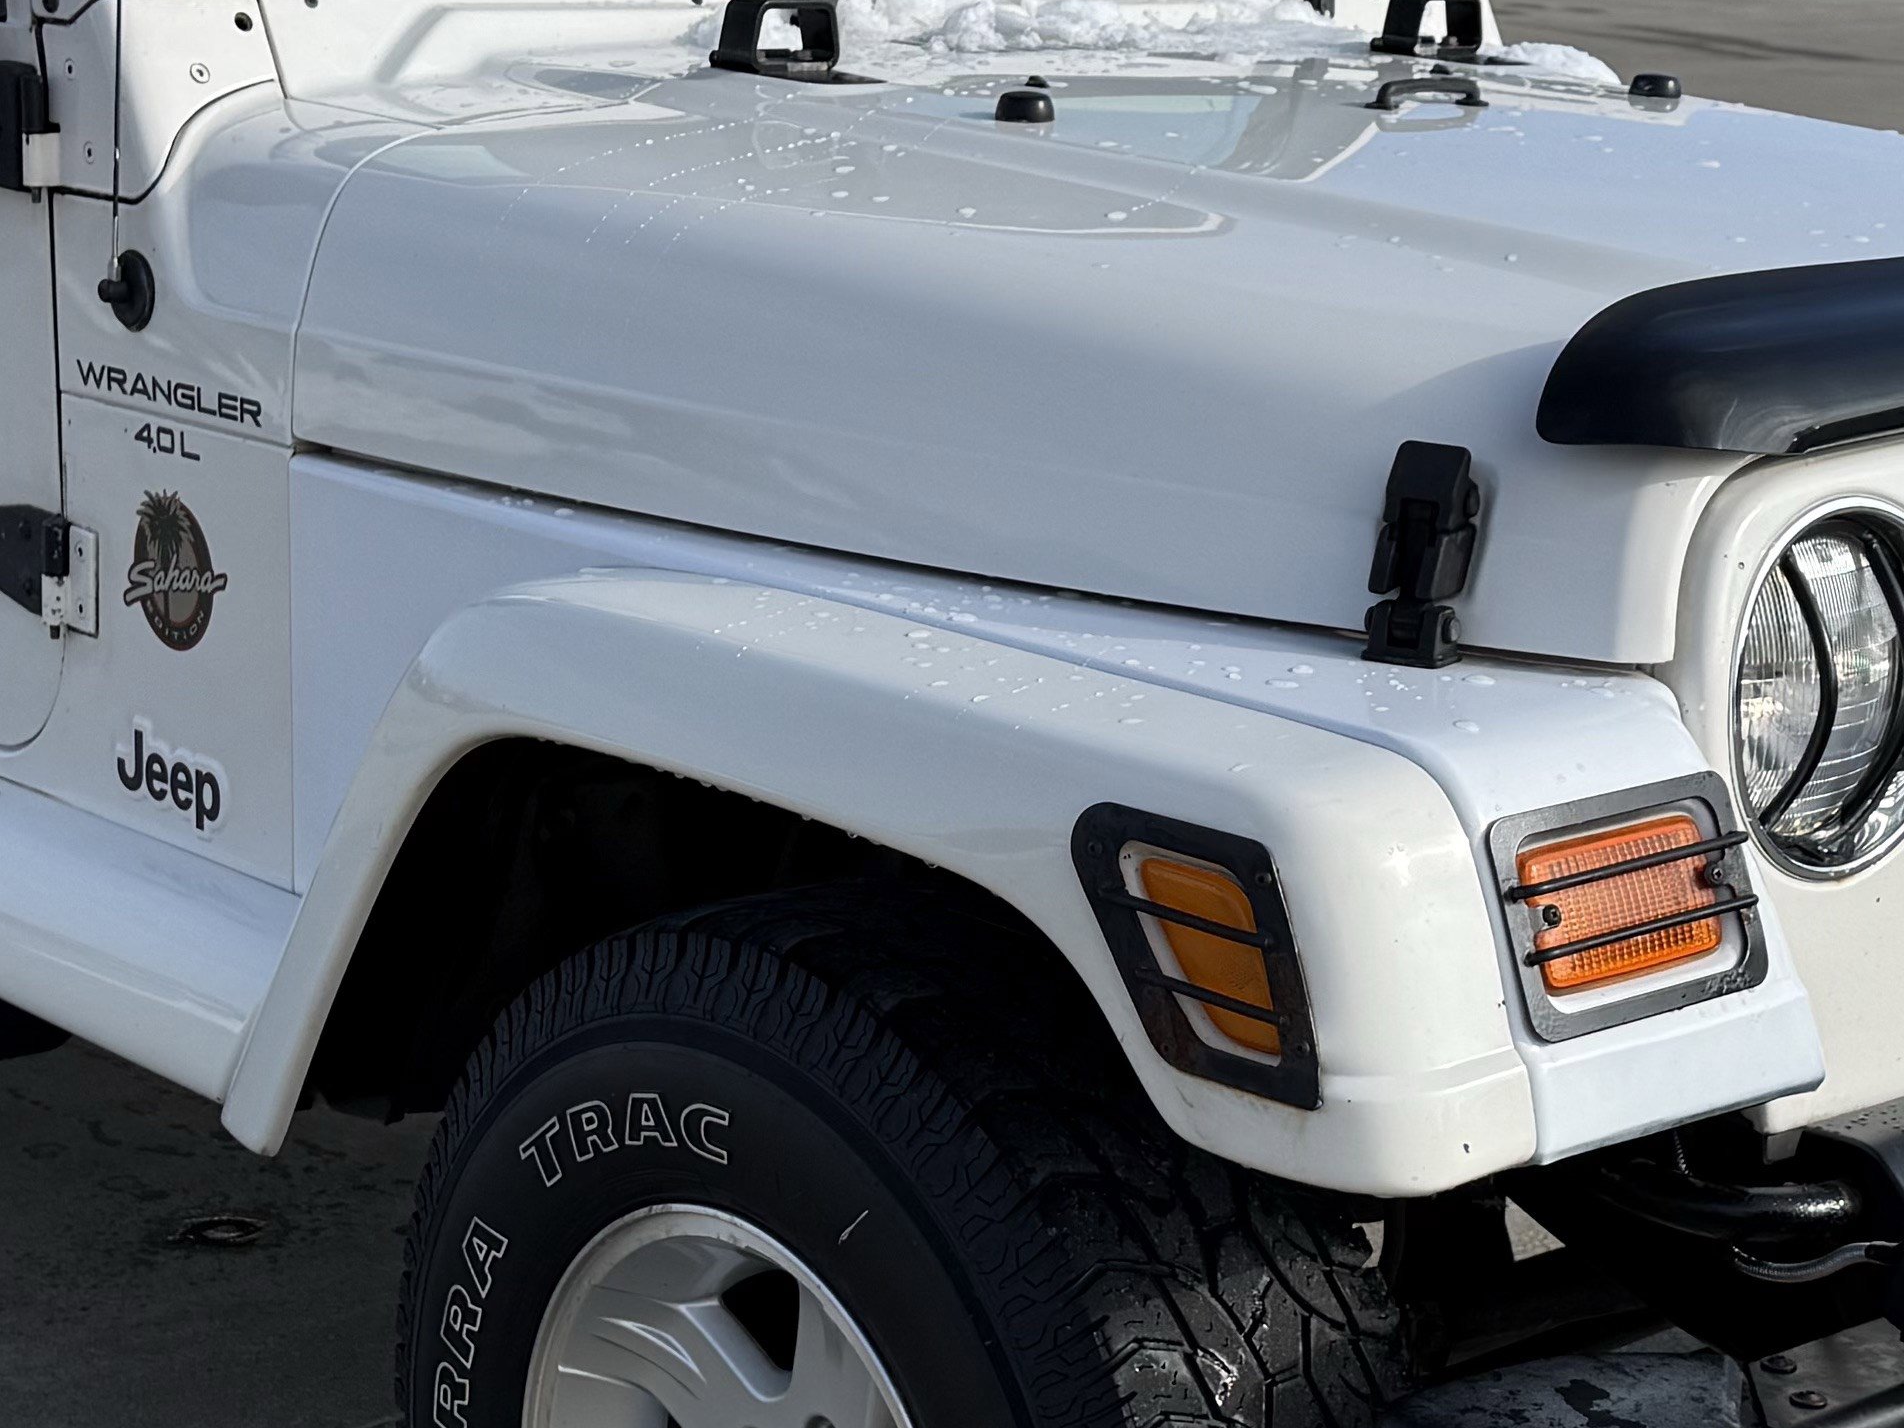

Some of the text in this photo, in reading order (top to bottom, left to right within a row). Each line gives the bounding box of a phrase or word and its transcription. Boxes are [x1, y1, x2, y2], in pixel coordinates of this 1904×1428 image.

[76, 359, 262, 428] WRANGLER
[124, 551, 227, 606] Sahara
[116, 728, 221, 831] Jeep
[519, 1090, 731, 1188] TRAC
